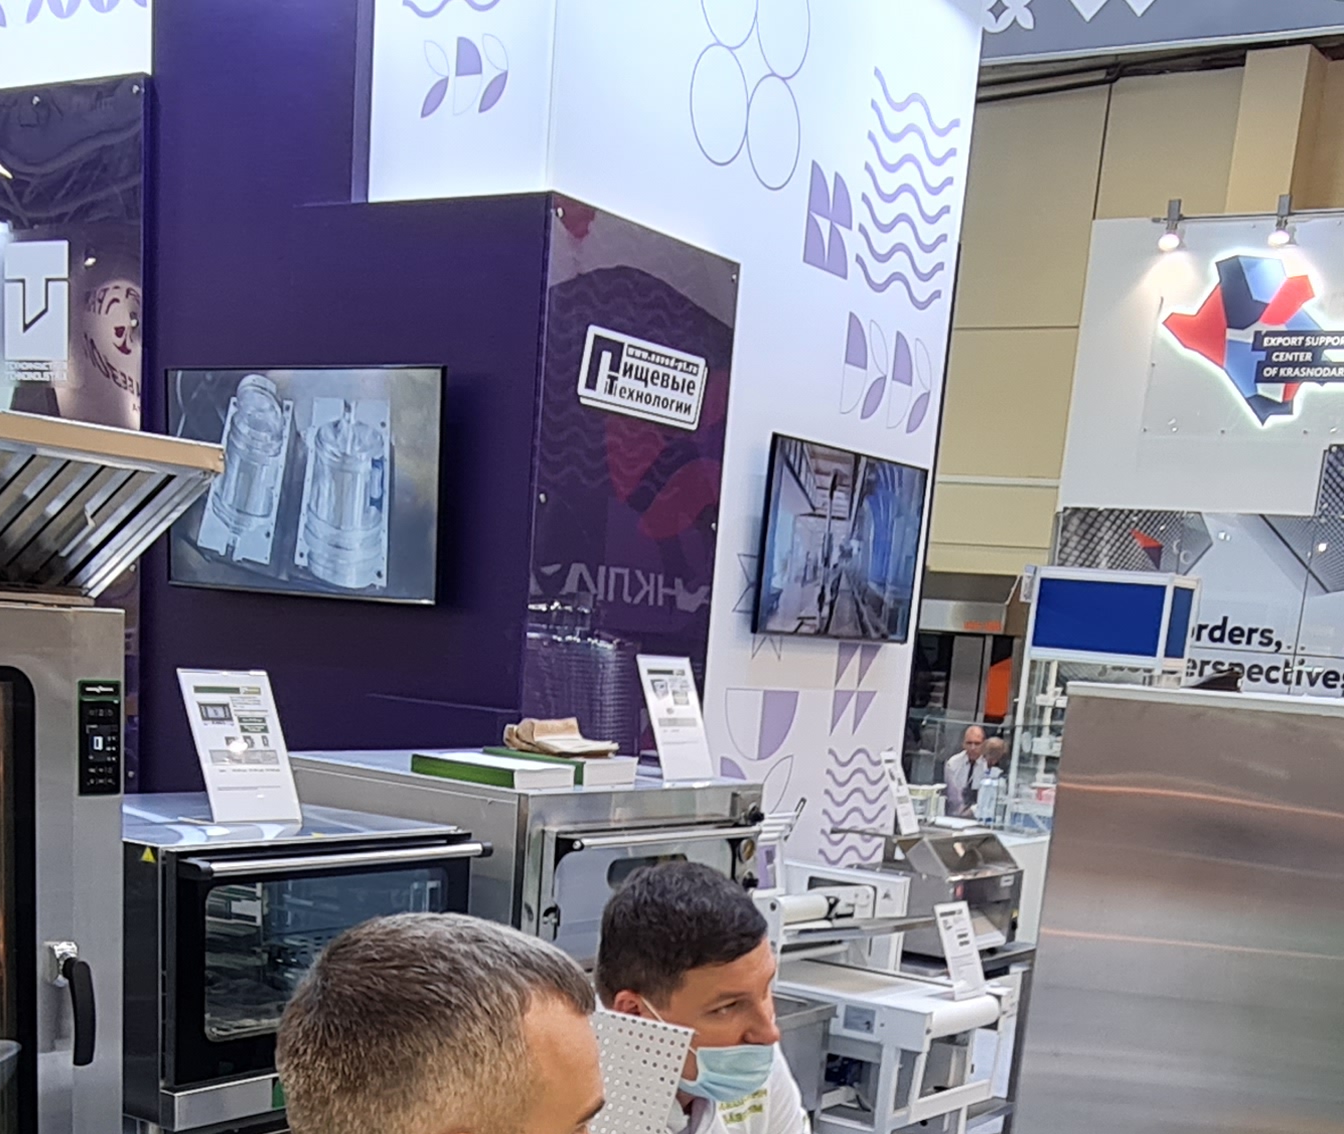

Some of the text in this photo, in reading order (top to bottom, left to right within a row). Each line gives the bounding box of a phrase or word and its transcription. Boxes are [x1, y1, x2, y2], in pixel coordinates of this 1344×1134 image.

[1263, 336, 1303, 347] EXPORT
[1271, 352, 1313, 362] CENTER
[1263, 367, 1278, 378] OF
[1279, 367, 1344, 378] KRASNODAR
[1191, 616, 1283, 653] rders,
